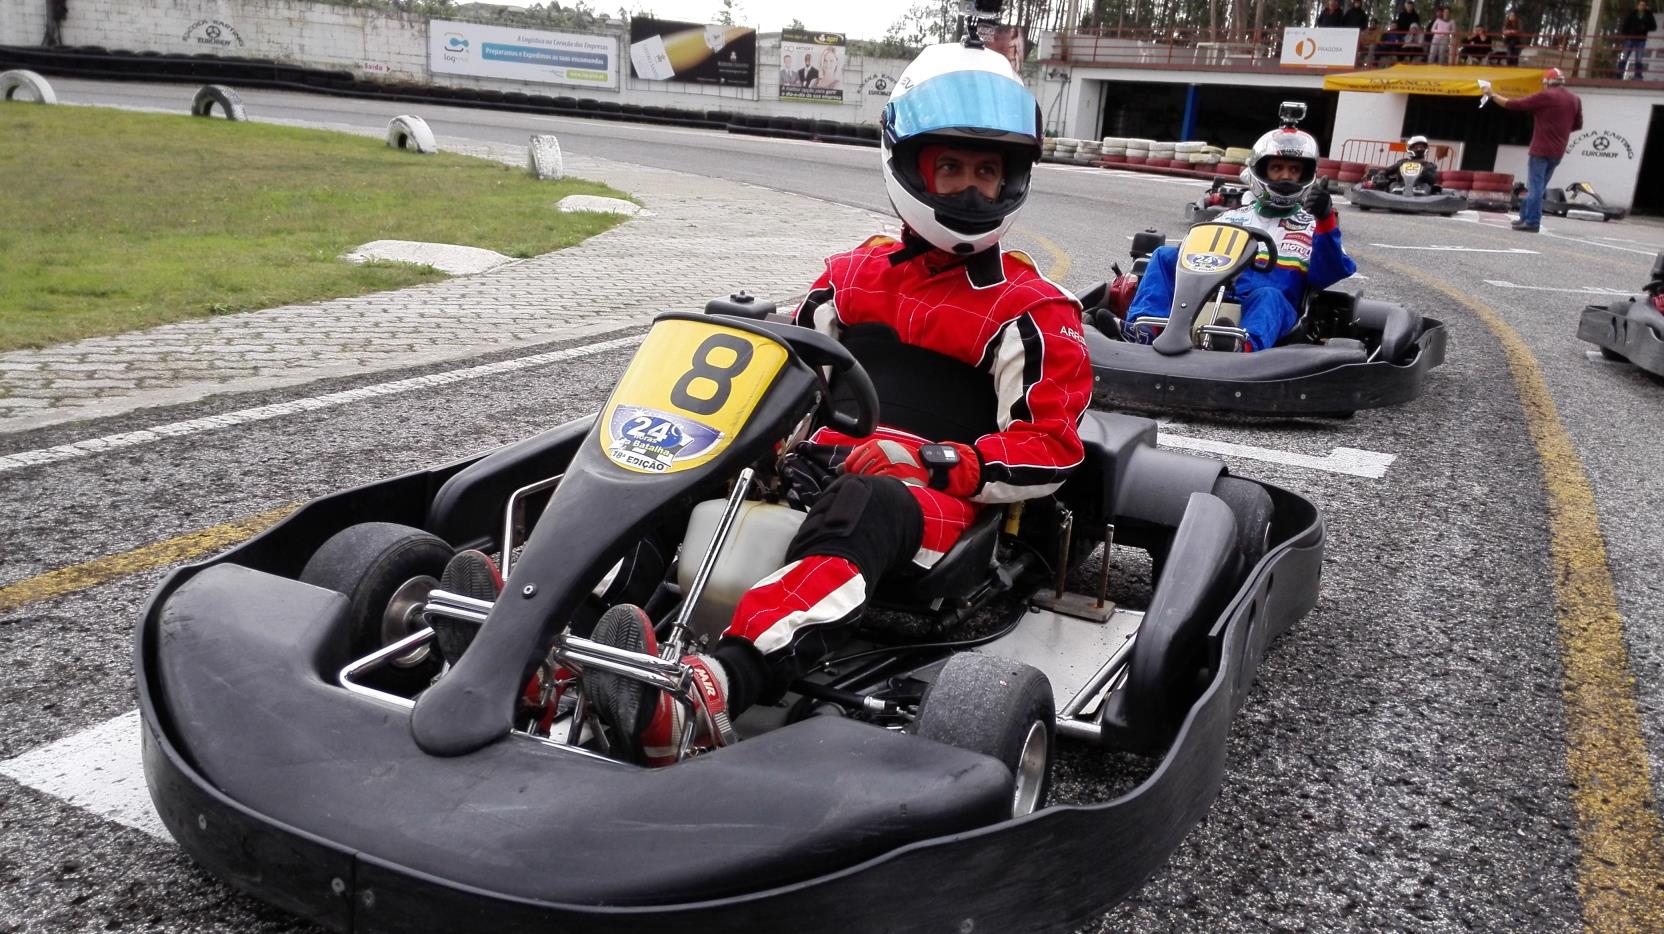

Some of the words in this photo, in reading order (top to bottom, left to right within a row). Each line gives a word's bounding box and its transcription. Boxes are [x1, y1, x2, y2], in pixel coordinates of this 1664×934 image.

[1566, 130, 1598, 154] ESCOLA
[1603, 130, 1634, 160] KARTING
[1209, 227, 1239, 256] 11
[1281, 242, 1311, 257] MOTUL
[670, 332, 754, 416] 8
[626, 416, 672, 442] 24
[633, 440, 671, 457] Batalha
[626, 455, 665, 471] EDIÇÃO
